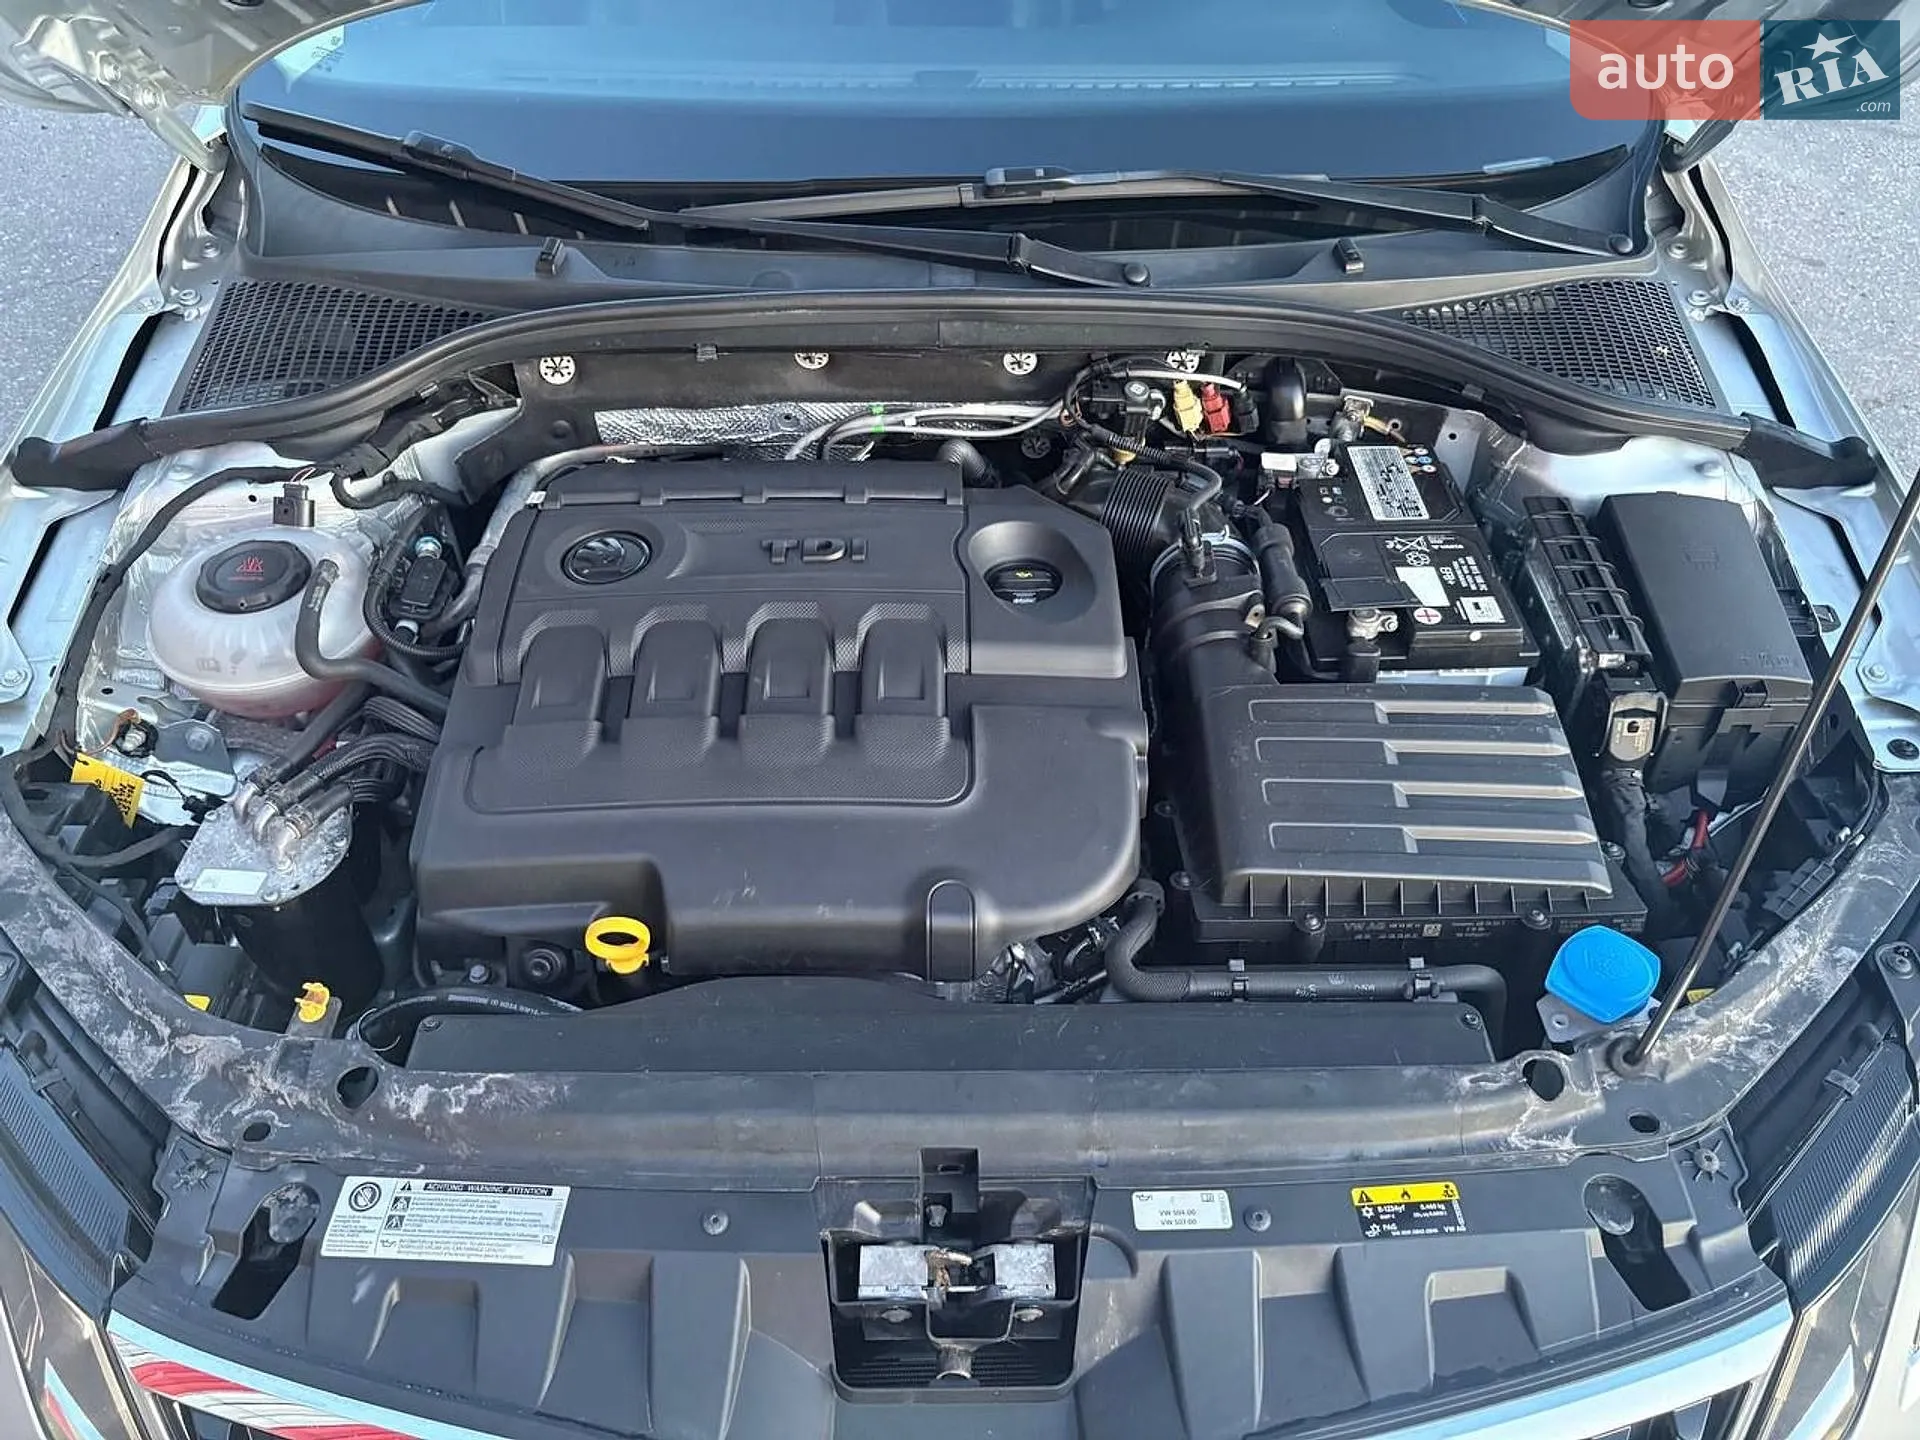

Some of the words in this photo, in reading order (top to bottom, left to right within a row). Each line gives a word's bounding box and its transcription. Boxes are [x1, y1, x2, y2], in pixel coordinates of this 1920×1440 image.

[760, 538, 868, 563] TDI
[426, 1183, 463, 1191] ACHTUNG
[468, 1184, 503, 1193] WARNING
[507, 1186, 549, 1195] ATTENTION
